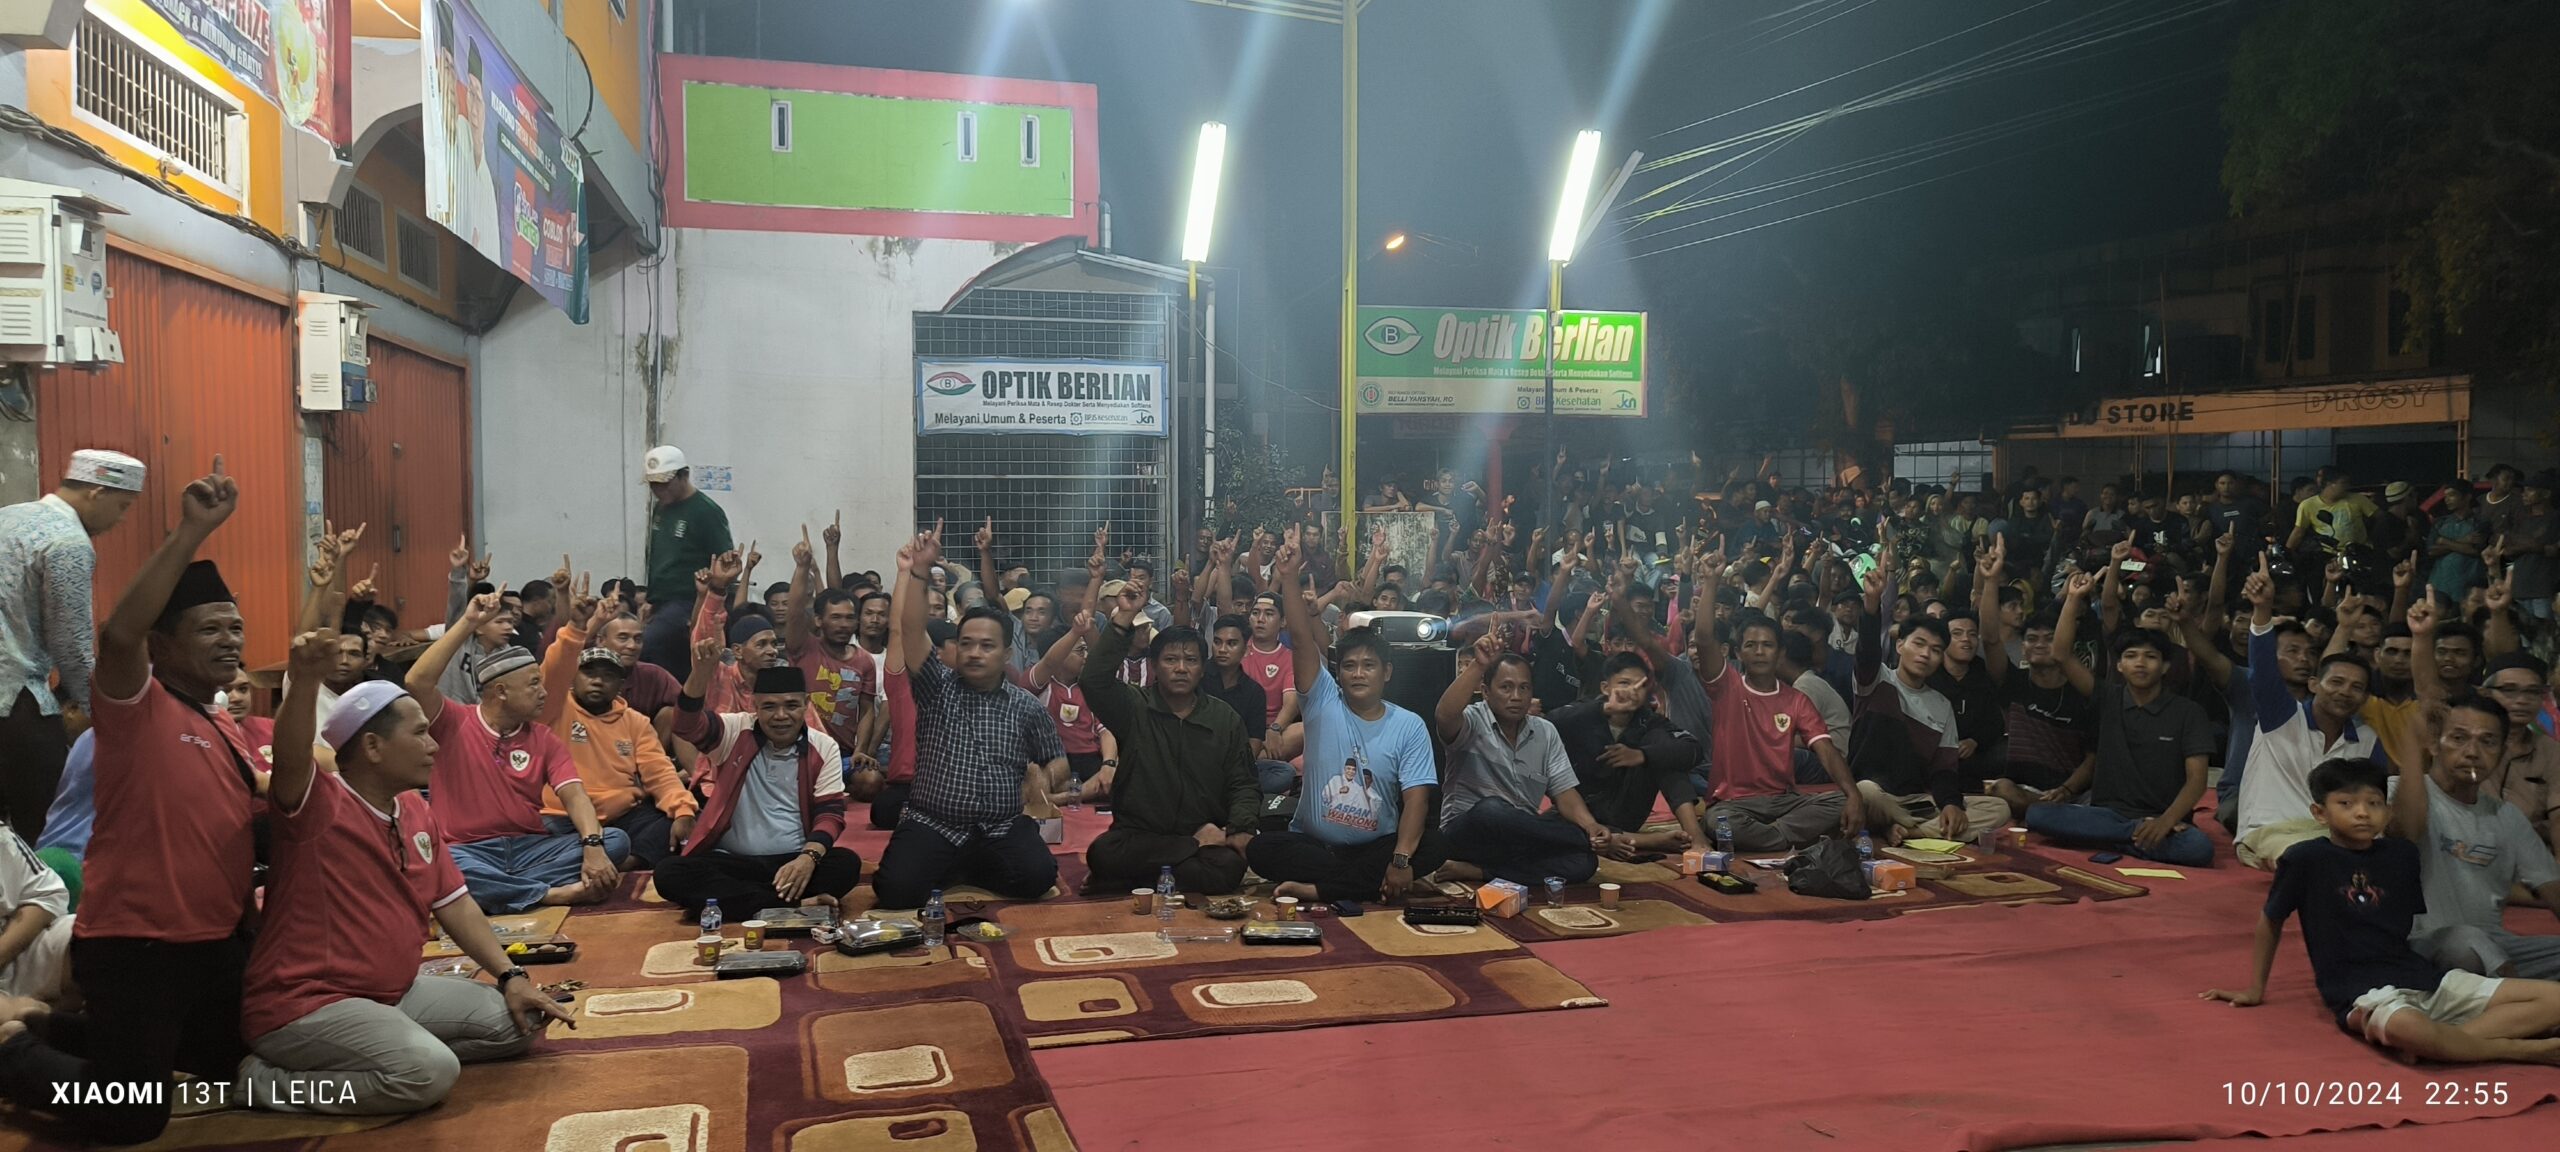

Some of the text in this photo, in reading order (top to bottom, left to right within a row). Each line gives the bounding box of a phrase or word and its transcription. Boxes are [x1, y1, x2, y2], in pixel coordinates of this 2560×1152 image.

[192, 14, 199, 33] &
[237, 46, 263, 80] GRATIS
[1384, 325, 1399, 344] B
[1433, 313, 1635, 365] Optik Berlian
[982, 370, 1151, 401] OPTIK BERLIAN
[1555, 396, 1601, 406] Kesehatan
[2304, 382, 2433, 414] D'ROSY
[935, 413, 1066, 426] Melayani Umum & Peserta
[2107, 401, 2194, 424] STORE
[1334, 802, 1371, 818] ASPAN
